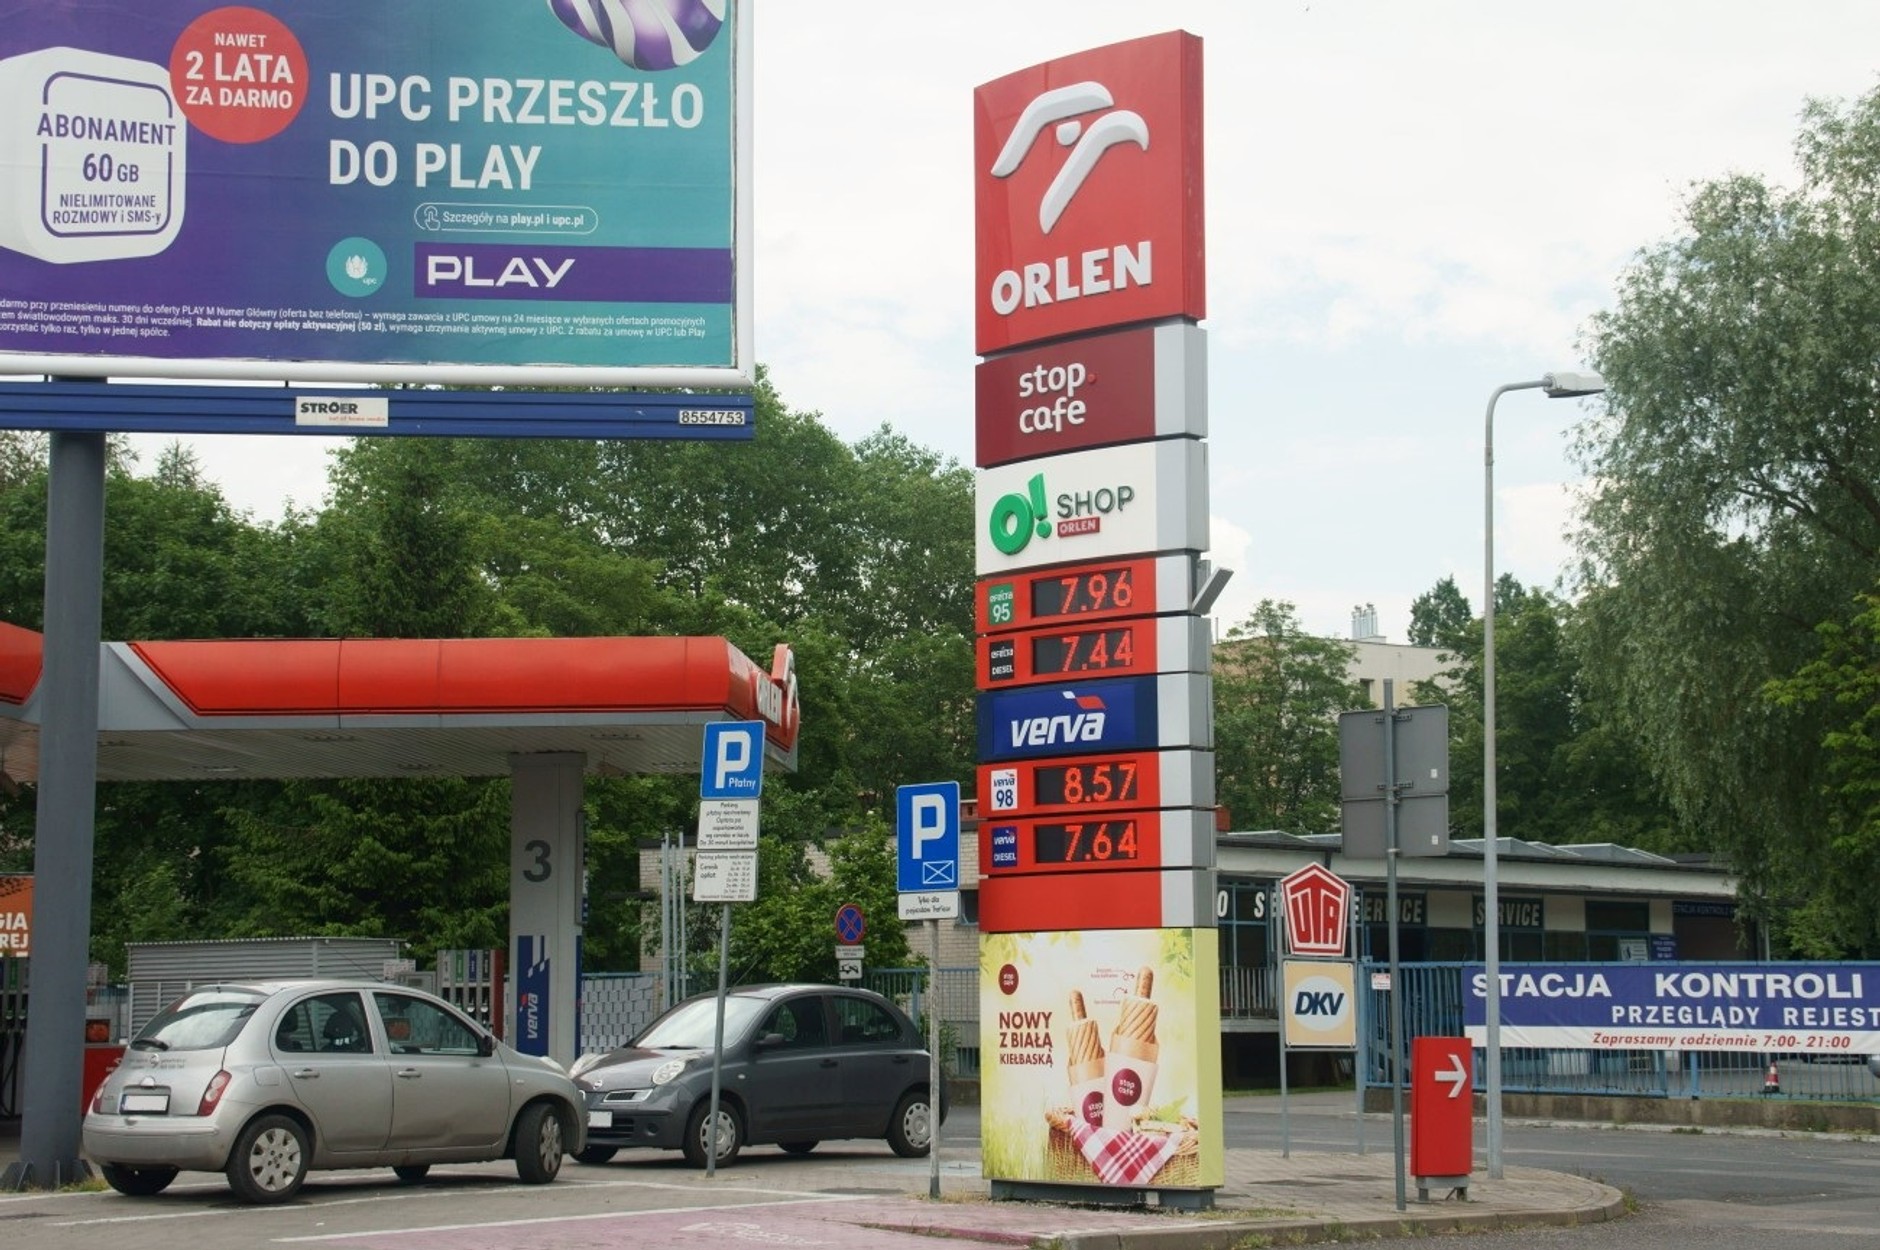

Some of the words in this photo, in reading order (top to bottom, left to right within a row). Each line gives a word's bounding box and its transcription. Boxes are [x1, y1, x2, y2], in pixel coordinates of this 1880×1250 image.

[215, 32, 266, 48] NAWET
[186, 51, 204, 80] 2
[215, 52, 294, 84] LATA
[186, 86, 213, 106] ZA
[219, 88, 293, 110] DARMO
[330, 73, 431, 121] UPC
[448, 76, 704, 129] PRZESZŁO
[37, 113, 176, 146] ABONAMENT
[82, 153, 112, 182] 60
[117, 164, 139, 182] GB
[330, 139, 398, 187] DO
[415, 143, 542, 190] PLAY
[60, 194, 156, 208] NIELIMITOWANE
[53, 210, 118, 224] ROZMOWY
[121, 210, 124, 223] i
[127, 210, 161, 225] SMS-y
[442, 211, 493, 226] Szczegóły
[496, 214, 509, 224] na
[510, 212, 544, 227] play.pl
[552, 214, 584, 228] upc.pl
[427, 255, 576, 288] PLAY
[992, 240, 1152, 316] ORLEN
[122, 315, 133, 324] 30
[135, 315, 148, 324] dni
[222, 318, 236, 328] nie
[142, 304, 154, 314] do
[182, 305, 204, 315] PLAY
[206, 306, 214, 315] M
[452, 312, 470, 322] UPC
[514, 314, 524, 324] 24
[1019, 362, 1086, 398] stop
[300, 402, 358, 414] STRÖER
[681, 411, 743, 424] 8554753
[1019, 397, 1086, 434] cafe
[1057, 485, 1134, 518] SHOP
[1060, 518, 1096, 534] ORLEN
[992, 602, 1010, 622] 95
[1061, 570, 1132, 614] 7.96
[992, 664, 1014, 675] DIESEL
[1062, 631, 1134, 672] 7.44
[1011, 712, 1106, 748] verva
[728, 778, 756, 790] Płatny
[996, 789, 1014, 808] 98
[1064, 763, 1137, 804] 8.57
[994, 852, 1016, 862] DIESEL
[1065, 822, 1137, 861] 7.64
[522, 840, 552, 883] 3
[1289, 873, 1342, 944] UTA
[1476, 902, 1540, 927] SRVICE
[1472, 973, 1612, 998] STACJA
[1656, 972, 1863, 999] KONTROLI
[1294, 991, 1344, 1016] DKV
[526, 993, 539, 1040] verva
[999, 1012, 1053, 1030] NOWY
[1612, 1005, 1760, 1028] PRZEGLĄDY
[1783, 1007, 1880, 1027] REJEST
[999, 1032, 1008, 1048] Z
[1010, 1032, 1054, 1052] BIAŁĄ
[1593, 1032, 1676, 1047] Zapraszamy
[1680, 1033, 1758, 1046] codziennie
[1806, 1036, 1851, 1048] 21:00
[1000, 1054, 1054, 1068] KIEŁBASKĄ
[1118, 1079, 1135, 1090] stop
[1118, 1086, 1134, 1096] cafe
[1090, 1110, 1104, 1119] caf
